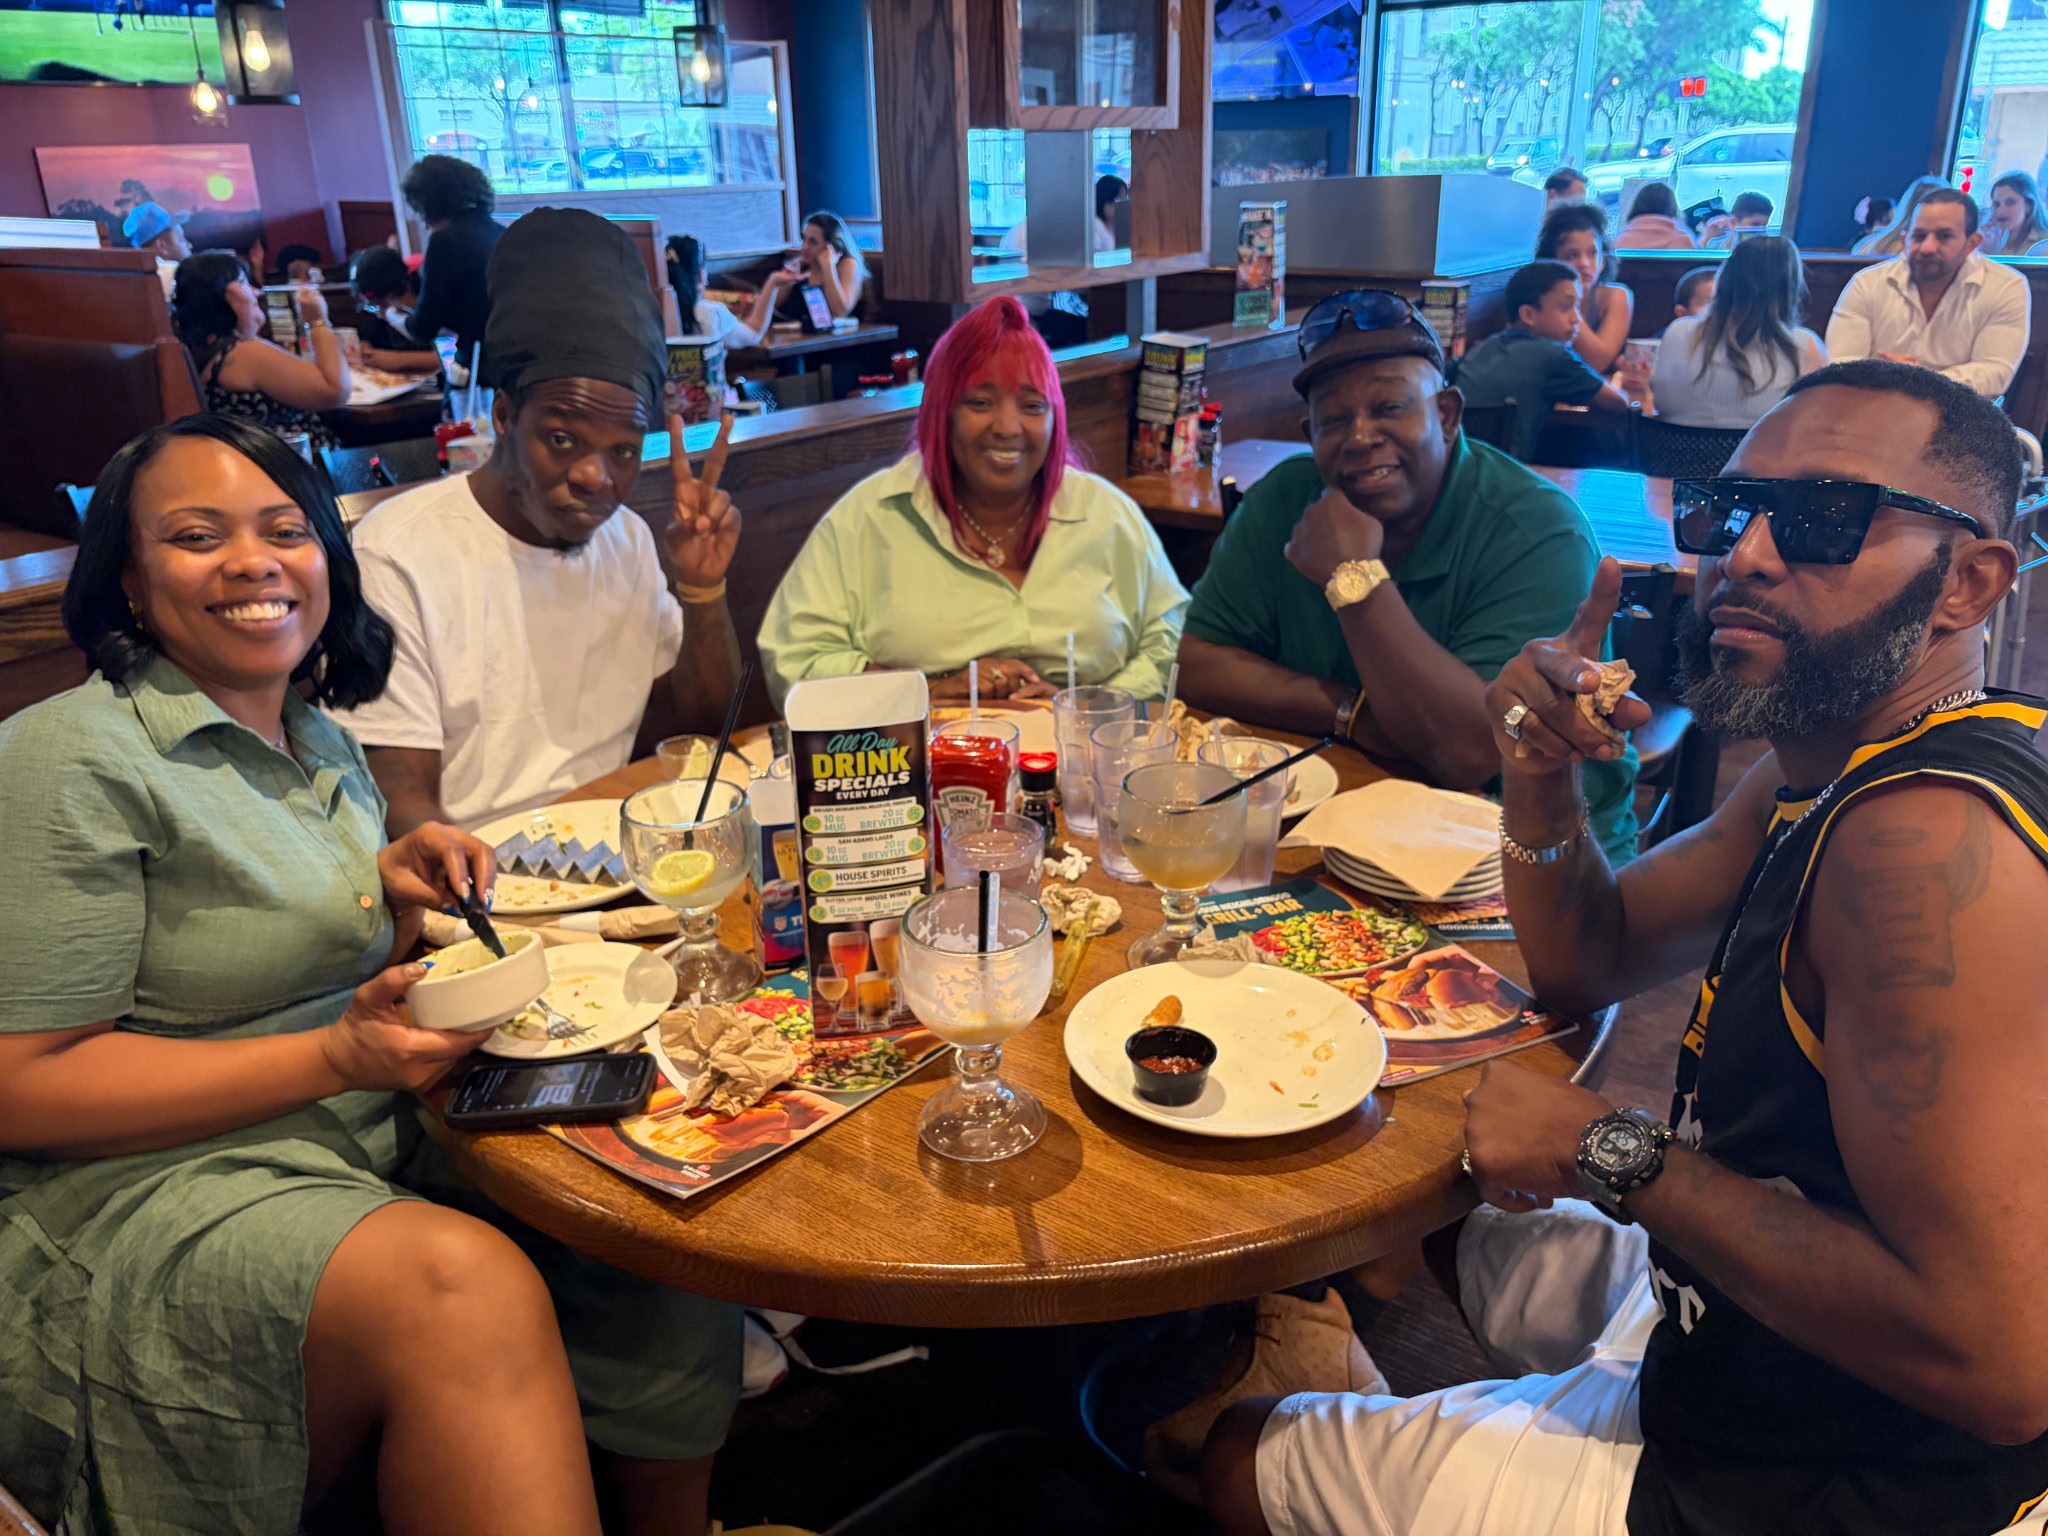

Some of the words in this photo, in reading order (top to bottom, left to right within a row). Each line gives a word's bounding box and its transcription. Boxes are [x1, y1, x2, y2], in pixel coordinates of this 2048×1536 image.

[827, 734, 860, 753] All
[861, 731, 897, 754] Day
[812, 745, 911, 778] DRINK
[814, 771, 911, 792] SPECIALS
[836, 790, 868, 800] EVERY
[870, 787, 890, 797] DAY
[949, 795, 976, 803] HEINZ
[882, 809, 894, 818] 20
[949, 809, 979, 817] TOMATO
[824, 814, 834, 823] 10
[860, 816, 905, 830] BREWTUS
[825, 823, 846, 832] MUG
[884, 841, 895, 849] 20
[827, 846, 836, 854] 10
[862, 848, 906, 861] BREWTUS
[827, 855, 848, 863] MUG
[835, 871, 868, 881] HOUSE
[870, 866, 907, 879] SPIRITS
[889, 890, 911, 898] WINES
[829, 905, 836, 914] 6
[1201, 908, 1258, 925] GRILL
[1260, 898, 1304, 916] BAR
